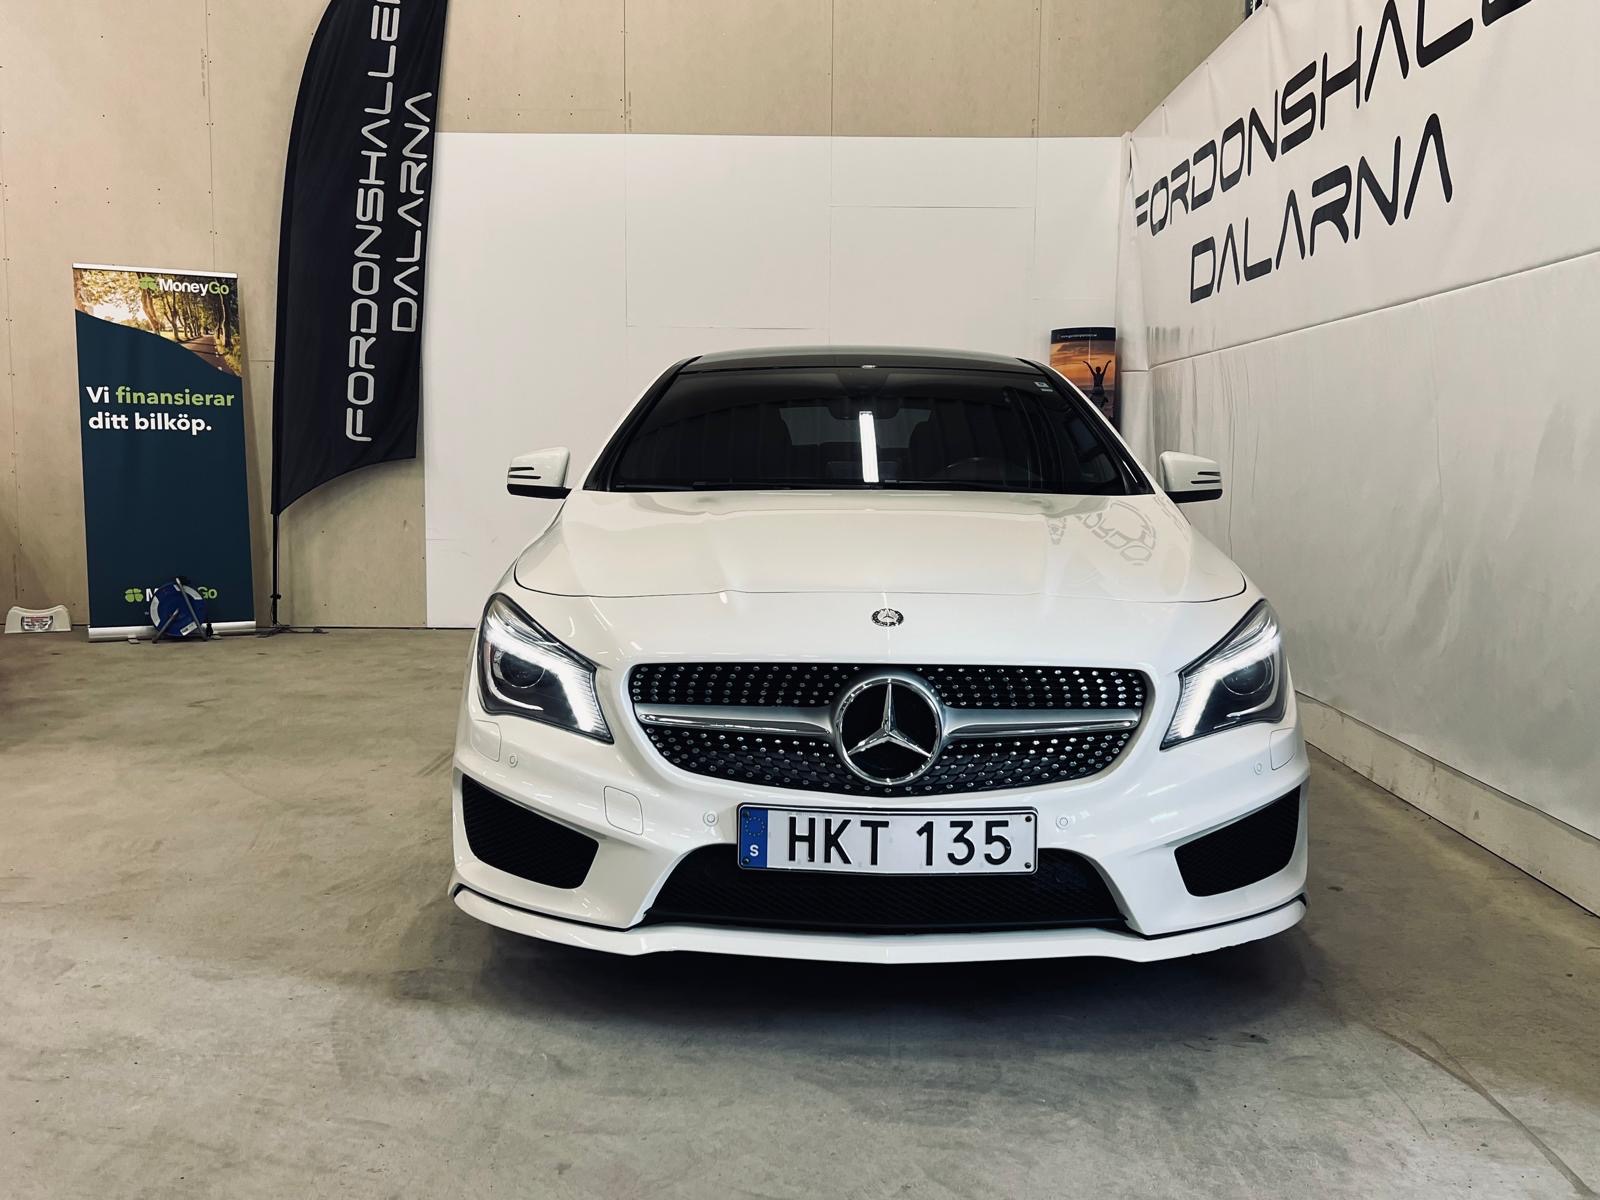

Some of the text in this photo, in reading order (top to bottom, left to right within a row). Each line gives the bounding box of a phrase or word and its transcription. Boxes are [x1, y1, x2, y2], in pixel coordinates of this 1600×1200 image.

[345, 0, 401, 442] FORDONSHALLE
[391, 91, 433, 333] DALARNA
[1190, 113, 1453, 304] DALARNA
[159, 279, 230, 297] MoneyGo
[86, 386, 235, 407] Vi finansierar
[88, 412, 212, 436] ditt bilköp.
[749, 844, 759, 857] S
[788, 816, 1012, 866] HKT 135
